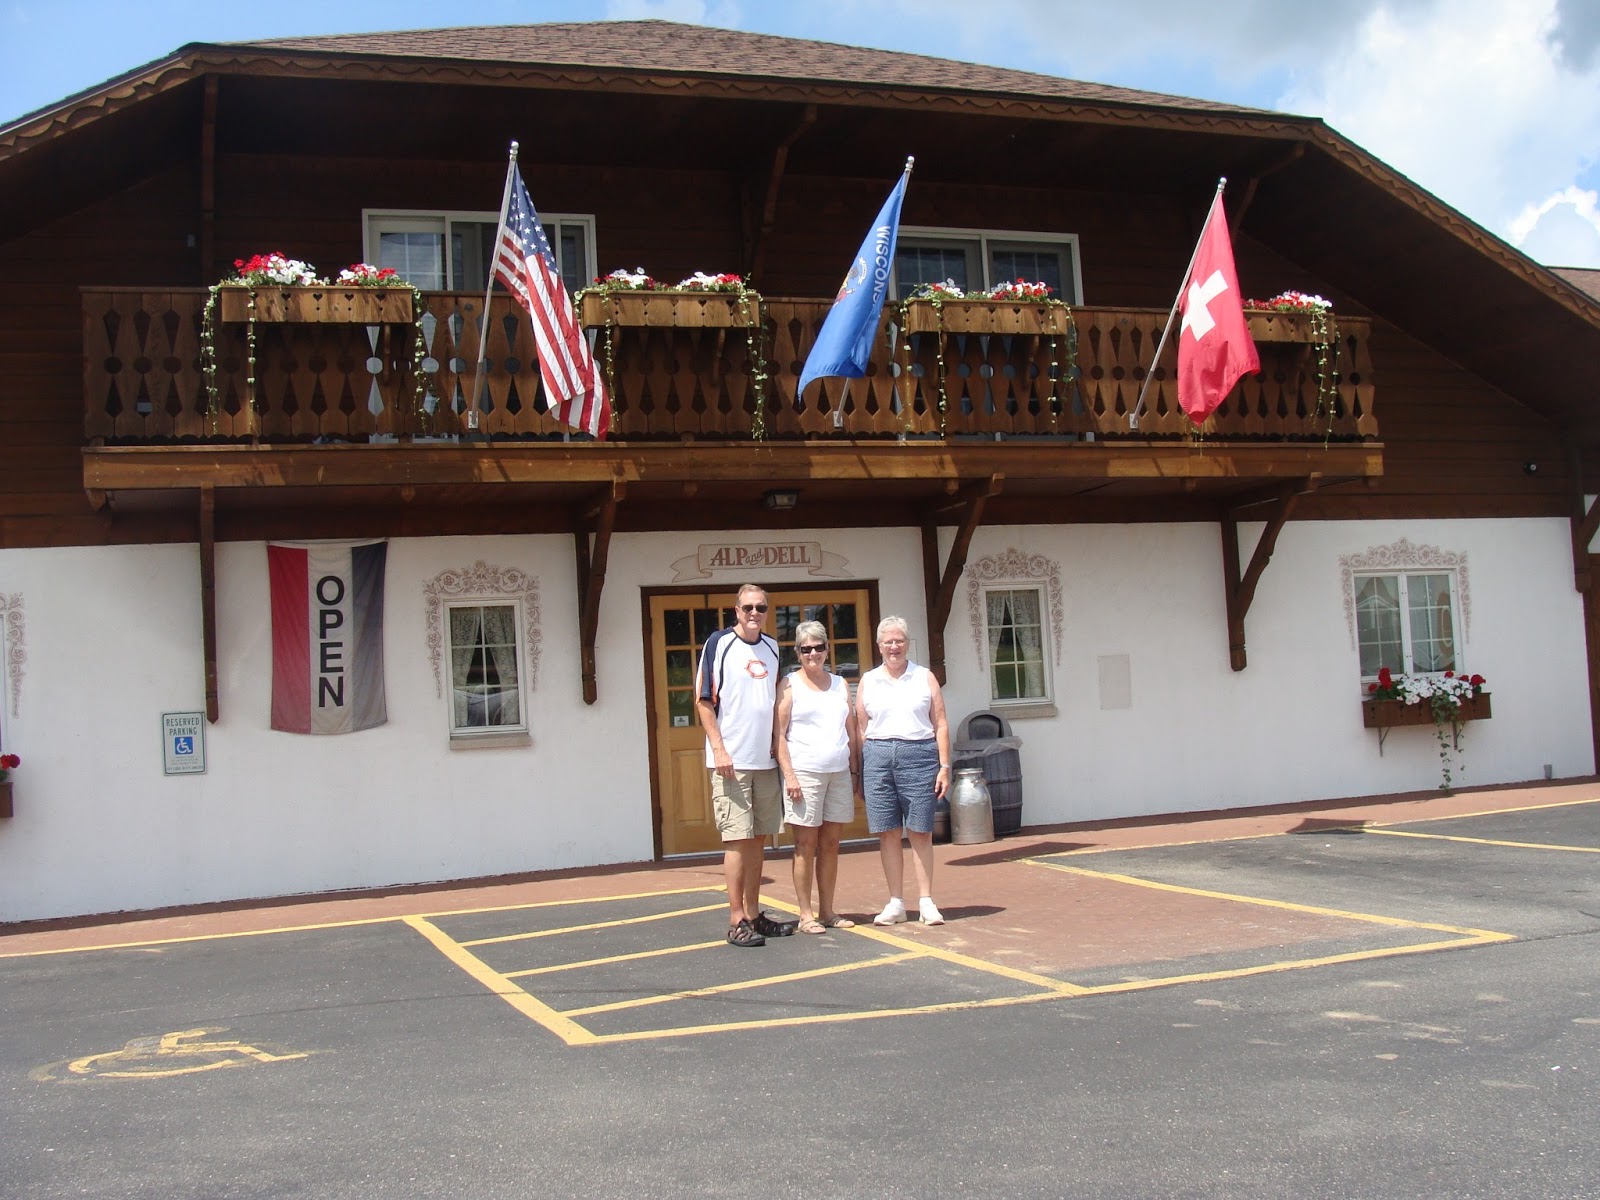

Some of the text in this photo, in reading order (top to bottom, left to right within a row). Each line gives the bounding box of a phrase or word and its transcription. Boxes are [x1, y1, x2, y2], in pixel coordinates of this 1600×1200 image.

[873, 225, 891, 303] WISCONS
[710, 546, 810, 567] ALP and DELL
[316, 575, 345, 708] OPEN
[744, 659, 769, 679] C
[166, 717, 200, 727] RESERVED
[169, 727, 198, 736] PARKING
